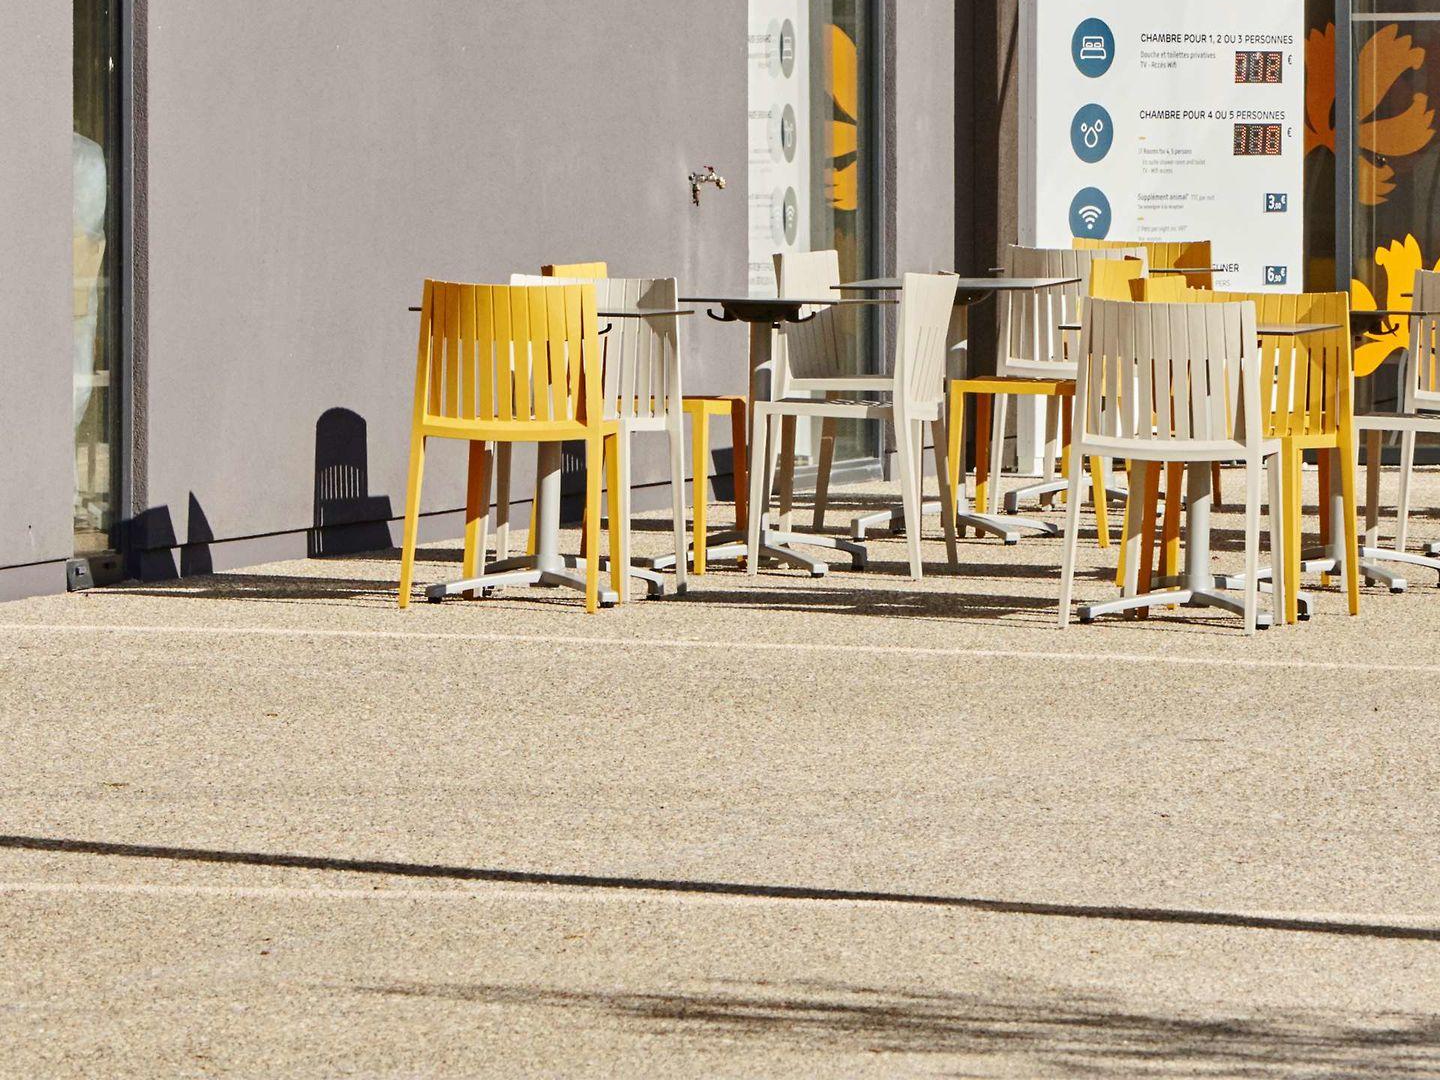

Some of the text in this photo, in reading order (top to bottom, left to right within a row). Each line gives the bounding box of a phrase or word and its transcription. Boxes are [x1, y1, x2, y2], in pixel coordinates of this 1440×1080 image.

[1140, 33, 1181, 43] CHAMBRE
[1184, 34, 1207, 43] POUR
[1217, 35, 1222, 43] 2
[1224, 35, 1236, 44] OU
[1238, 35, 1243, 44] 3
[1245, 35, 1293, 44] PERSONNES
[1139, 110, 1286, 120] CHAMBRE POUR 4 OU 5 PERSONNES
